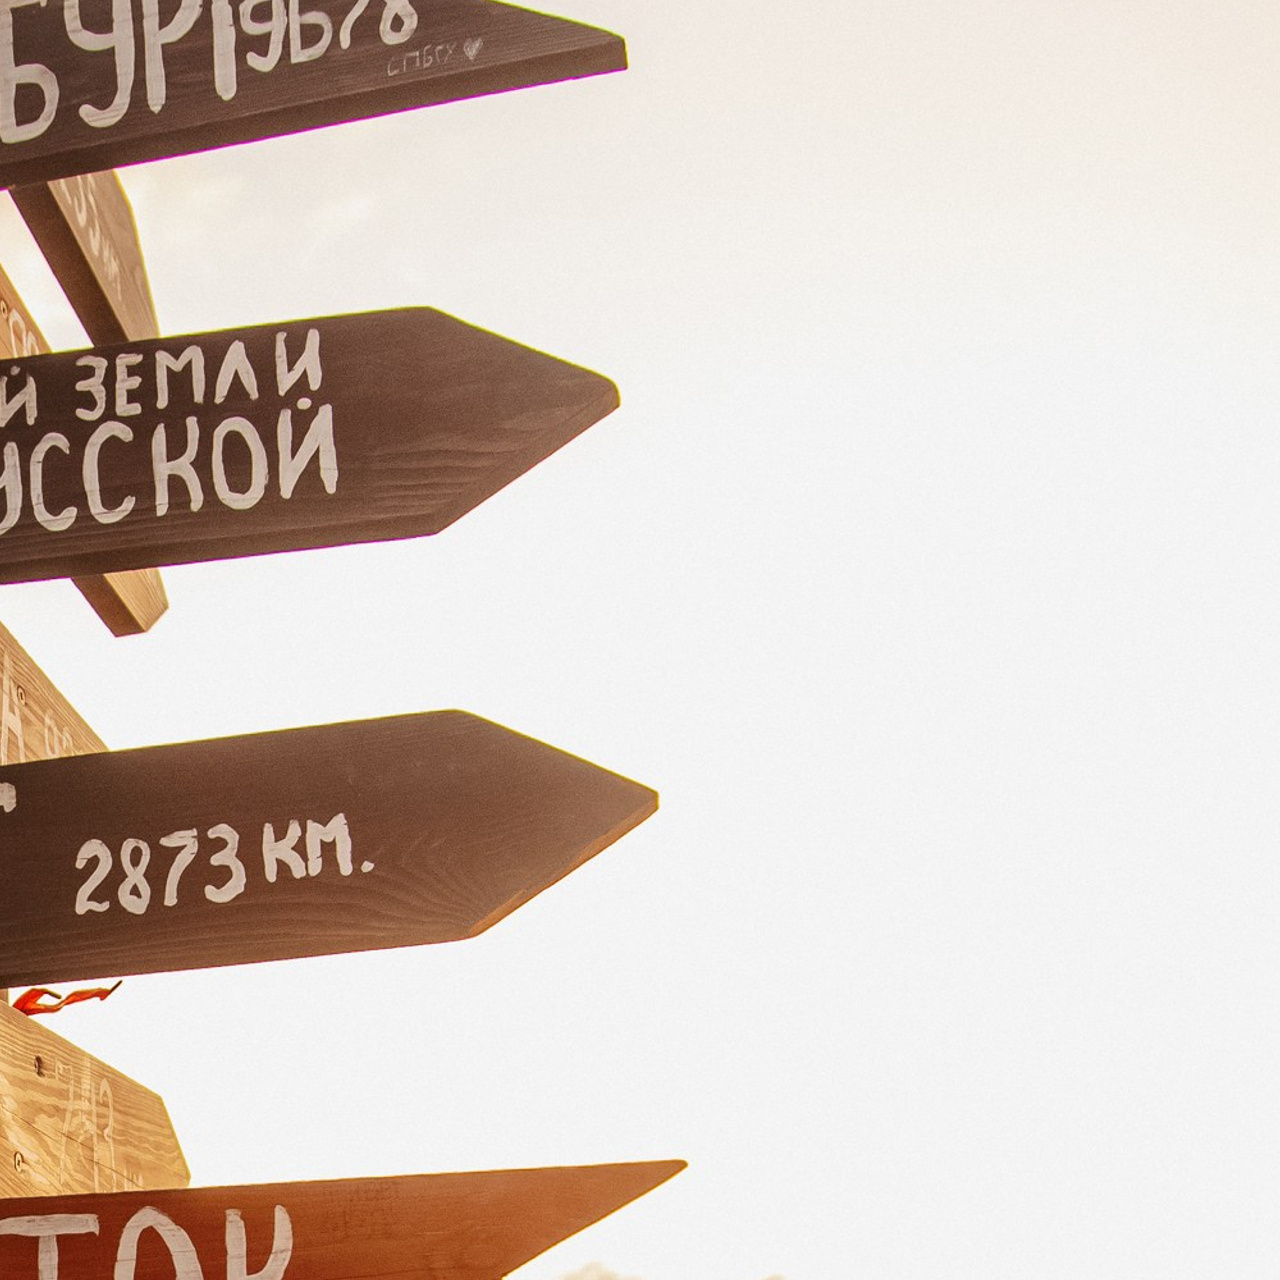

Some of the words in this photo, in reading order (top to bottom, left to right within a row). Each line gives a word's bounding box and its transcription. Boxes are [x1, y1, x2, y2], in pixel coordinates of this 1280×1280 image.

[75, 328, 322, 421] ЗЕМЛИ
[74, 822, 247, 915] 2873
[262, 813, 375, 882] КМ.
